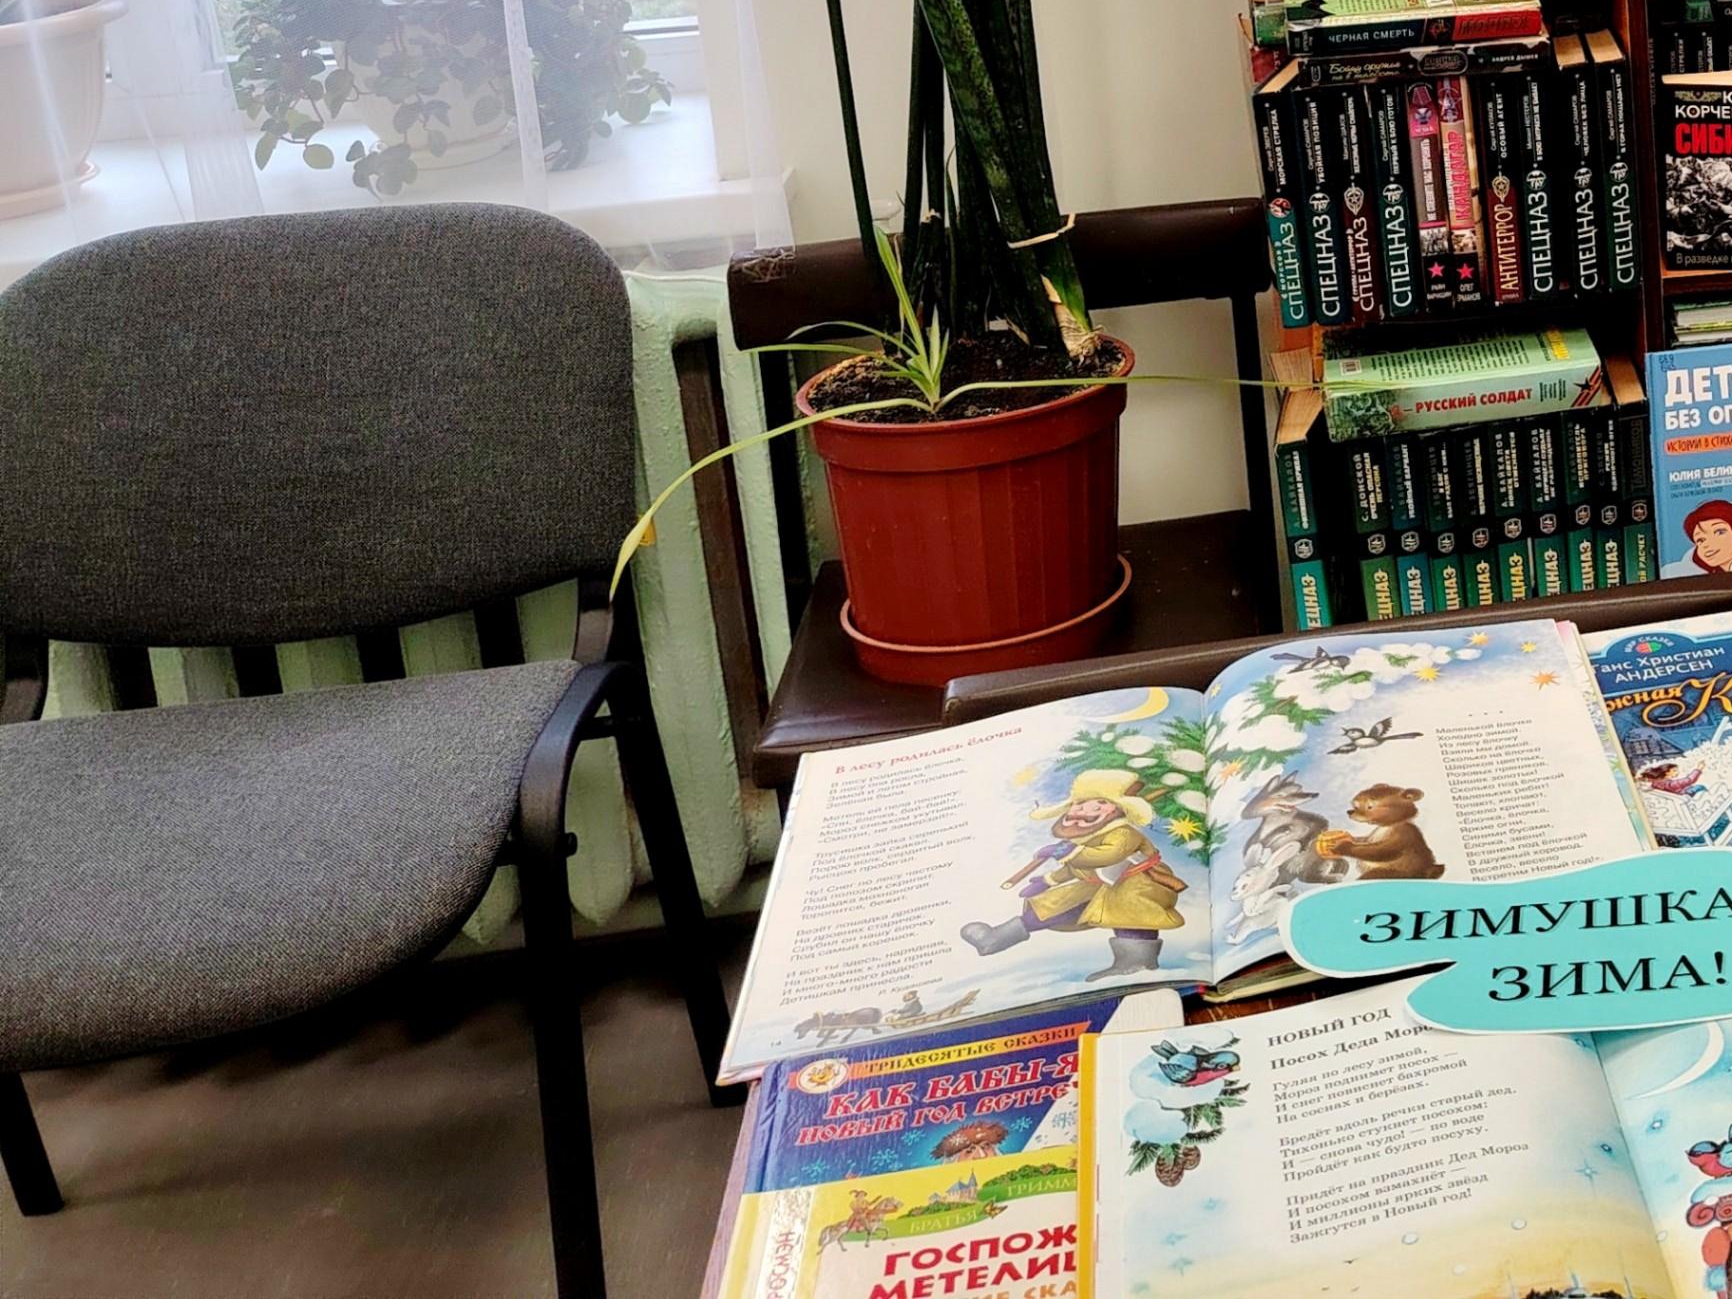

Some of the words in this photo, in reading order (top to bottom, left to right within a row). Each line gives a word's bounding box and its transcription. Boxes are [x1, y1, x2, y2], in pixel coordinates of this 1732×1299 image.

[1328, 32, 1369, 43] ЧЕРНАЯ
[1372, 28, 1415, 39] СМЕРТЬ
[1494, 203, 1520, 290] АНТИТЕРРОР
[1610, 182, 1637, 283] СПЕЦНАЗ
[1280, 221, 1305, 320] СПЕЦНАЗ
[1312, 213, 1341, 316] СПЕЦНАЗ
[1676, 253, 1683, 266] В
[1686, 254, 1727, 268] разведке
[1415, 395, 1477, 413] РУССКИЙ
[1480, 388, 1533, 405] СОЛДАТ
[1664, 409, 1701, 430] БЕЗ
[1669, 470, 1700, 481] ЮЛИЯ
[1615, 660, 1713, 684] АНДЕРСЕН
[1638, 646, 1725, 668] Христиан
[834, 765, 842, 775] В
[847, 758, 887, 774] лесу
[889, 741, 963, 770] родилась
[966, 726, 1023, 749] ёлочка
[1488, 951, 1728, 1003] ЗИМА!
[1267, 1018, 1345, 1047] НОВЫЙ
[1352, 1008, 1391, 1027] ГОД
[865, 1041, 996, 1073] ТРИДЕСЯТЫЕ
[1003, 1027, 1076, 1052] СКАЗКИ
[1270, 1048, 1328, 1070] Посох
[1334, 1037, 1378, 1056] Деда
[1273, 1075, 1318, 1091] Гуляя
[1322, 1068, 1339, 1079] по
[1343, 1058, 1374, 1075] лесу
[1378, 1048, 1427, 1064] зимой,
[824, 1081, 914, 1119] КАК
[927, 1052, 1079, 1098] БАБЫ-Я
[1273, 1086, 1321, 1103] Мороз
[1324, 1066, 1395, 1090] поднимет
[1399, 1056, 1439, 1068] посох
[1301, 1101, 1351, 1118] соснах
[1368, 1082, 1429, 1100] берёзах.
[795, 1111, 905, 1147] НОВЫЙ
[914, 1102, 967, 1126] ГОД
[909, 1207, 978, 1235] БРАТЬЯ
[883, 1223, 1078, 1277] ГОСПОЖ
